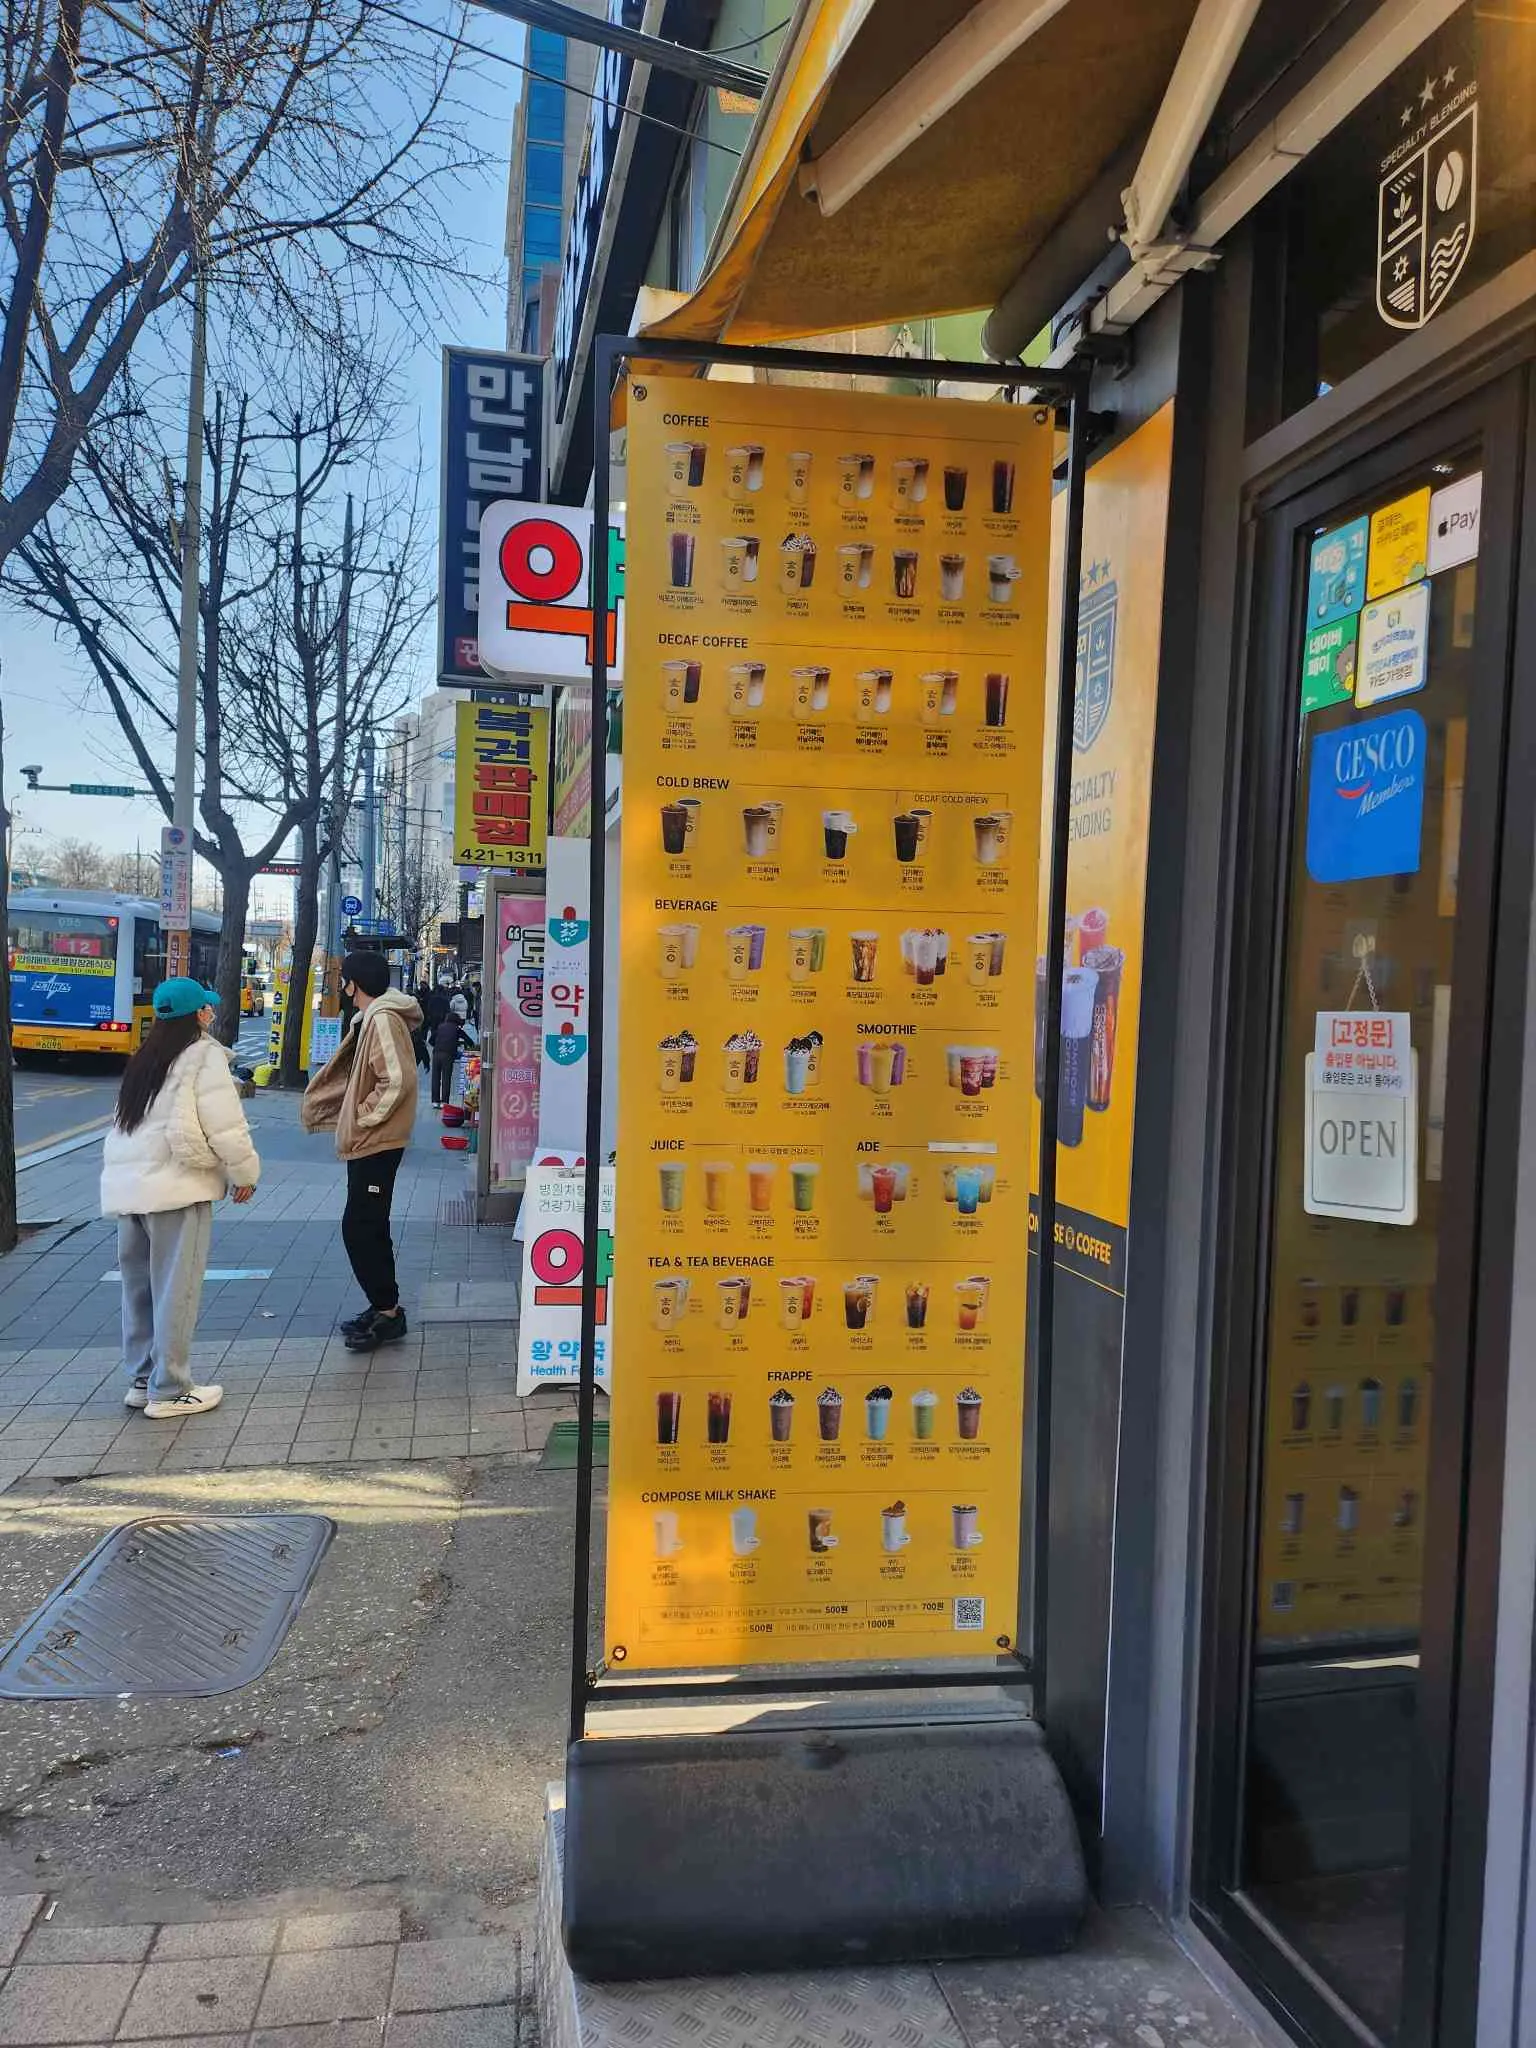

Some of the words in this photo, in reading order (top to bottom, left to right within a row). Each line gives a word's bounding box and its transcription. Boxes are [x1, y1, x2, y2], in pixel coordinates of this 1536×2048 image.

[1380, 125, 1428, 173] SPECIALTY
[1430, 81, 1478, 130] BLENDING
[663, 413, 710, 428] COFFEE
[1451, 508, 1478, 531] Pay
[658, 633, 699, 646] DECAF
[702, 635, 749, 649] COFFEE
[1335, 724, 1415, 783] CESCO
[656, 776, 689, 789] COLD
[693, 778, 730, 790] BREW
[914, 794, 940, 803] DECAF
[942, 795, 964, 804] COLD
[965, 795, 989, 805] BREW
[1356, 775, 1415, 819] Members
[461, 848, 542, 865] 421-1311
[655, 899, 718, 912] BEVERAGE
[551, 985, 585, 1017] 약
[857, 1023, 917, 1035] SMOOTHIE
[1332, 1018, 1392, 1048] [고정문]
[650, 1139, 685, 1150] JUICE
[1319, 1119, 1397, 1158] OPEN
[856, 1141, 880, 1152] ADE
[540, 1184, 612, 1196] 병원처방제
[540, 1200, 612, 1213] 건강기능품
[1076, 1232, 1111, 1264] COFFEE
[648, 1257, 670, 1267] TEA
[674, 1257, 682, 1267] &
[685, 1257, 709, 1267] TEA
[712, 1257, 774, 1267] BEVERAGE
[531, 1365, 566, 1376] Health
[767, 1371, 813, 1381] FRAPPE
[641, 1491, 701, 1503] COMPOSE
[704, 1490, 734, 1501] MILK
[737, 1489, 777, 1500] SHAKE
[825, 1605, 848, 1614] 500원
[922, 1602, 944, 1611] 700원
[749, 1624, 773, 1634] 500원
[867, 1619, 895, 1629] 1000원
